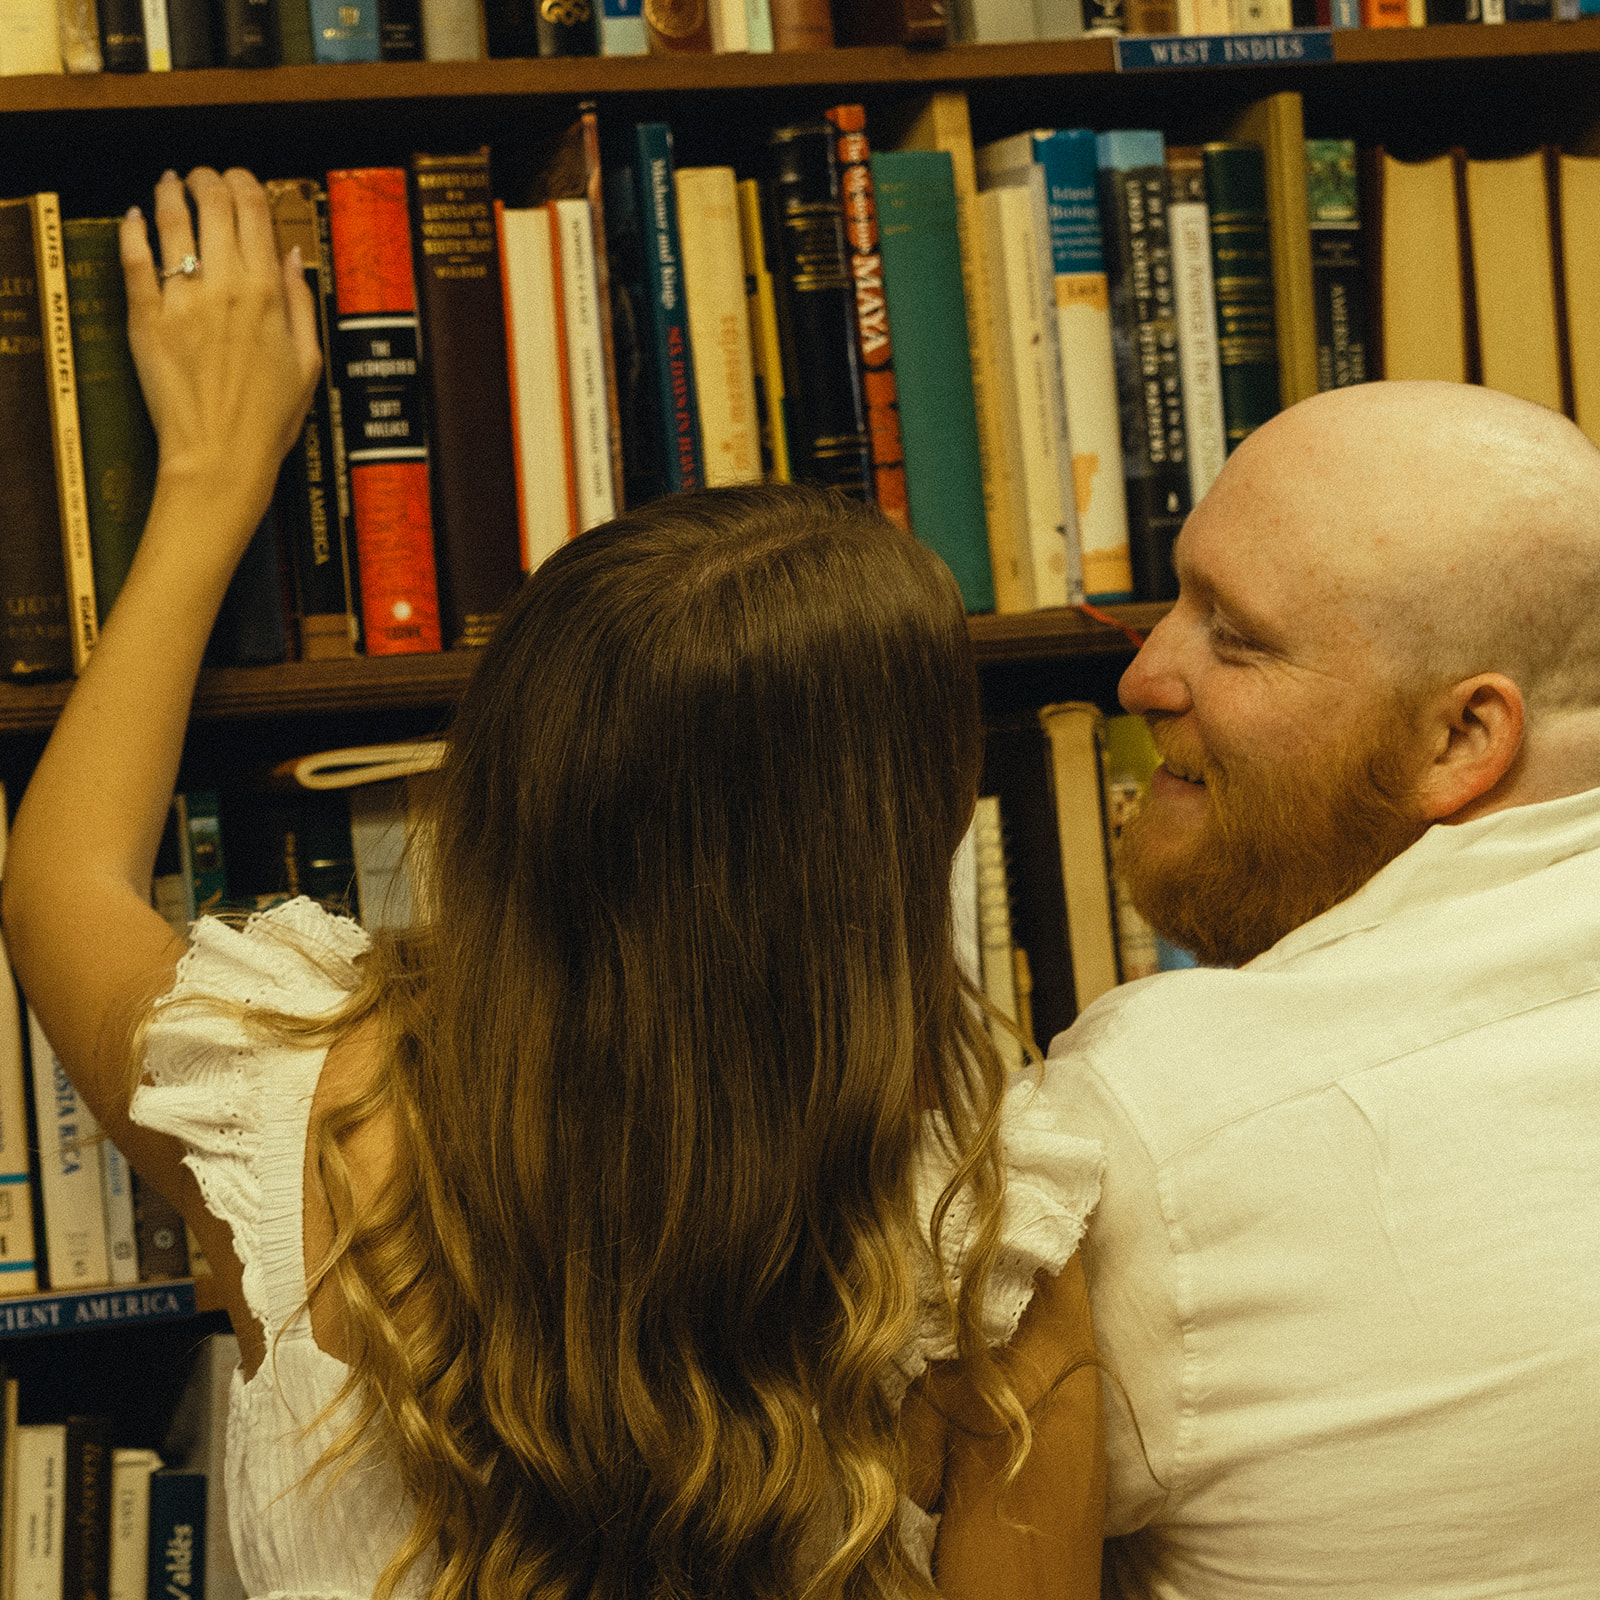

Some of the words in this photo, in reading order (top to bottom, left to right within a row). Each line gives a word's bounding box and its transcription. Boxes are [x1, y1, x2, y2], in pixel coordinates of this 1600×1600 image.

[1151, 40, 1208, 63] WEST
[1223, 37, 1303, 61] INDIES
[1126, 179, 1145, 233] LINDA
[43, 207, 61, 271] LUIS
[656, 232, 676, 264] and
[657, 265, 680, 311] Kings
[1130, 237, 1151, 300] SCHELE
[852, 255, 889, 354] MAYA
[51, 291, 72, 402] MIGUEL
[370, 340, 391, 356] THE
[1139, 322, 1158, 376] PETER
[364, 421, 410, 437] WALLACE
[369, 400, 401, 417] SCOTT
[303, 422, 324, 482] NORTH
[308, 486, 331, 566] AMERICA
[52, 1058, 77, 1118] OSTA
[58, 1123, 83, 1176] RICA
[75, 1292, 180, 1324] AMERICA
